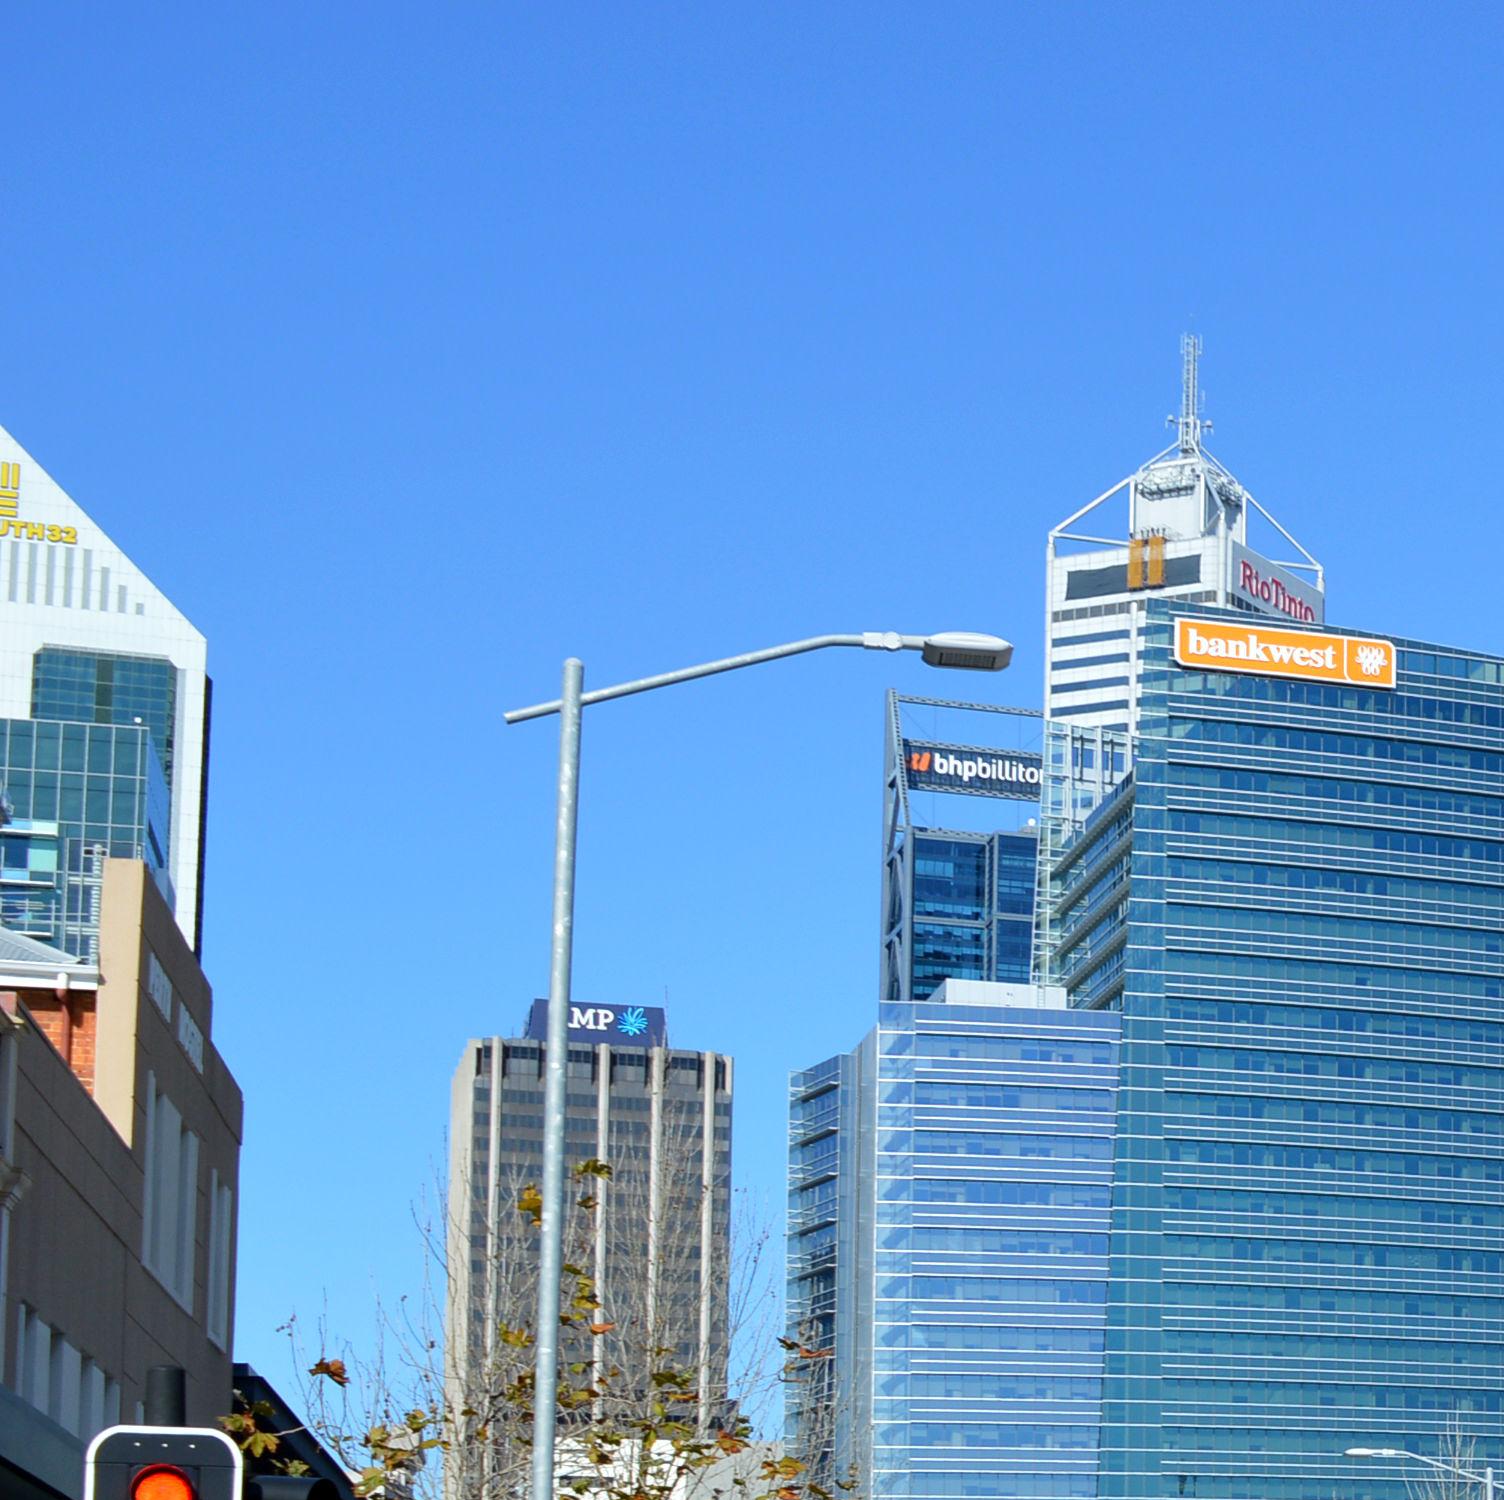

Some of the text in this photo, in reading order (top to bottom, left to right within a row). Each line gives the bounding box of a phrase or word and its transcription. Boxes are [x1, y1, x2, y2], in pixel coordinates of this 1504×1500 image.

[1187, 627, 1336, 670] bankwest
[934, 752, 1043, 785] bhpbillito
[567, 1007, 615, 1030] MP
